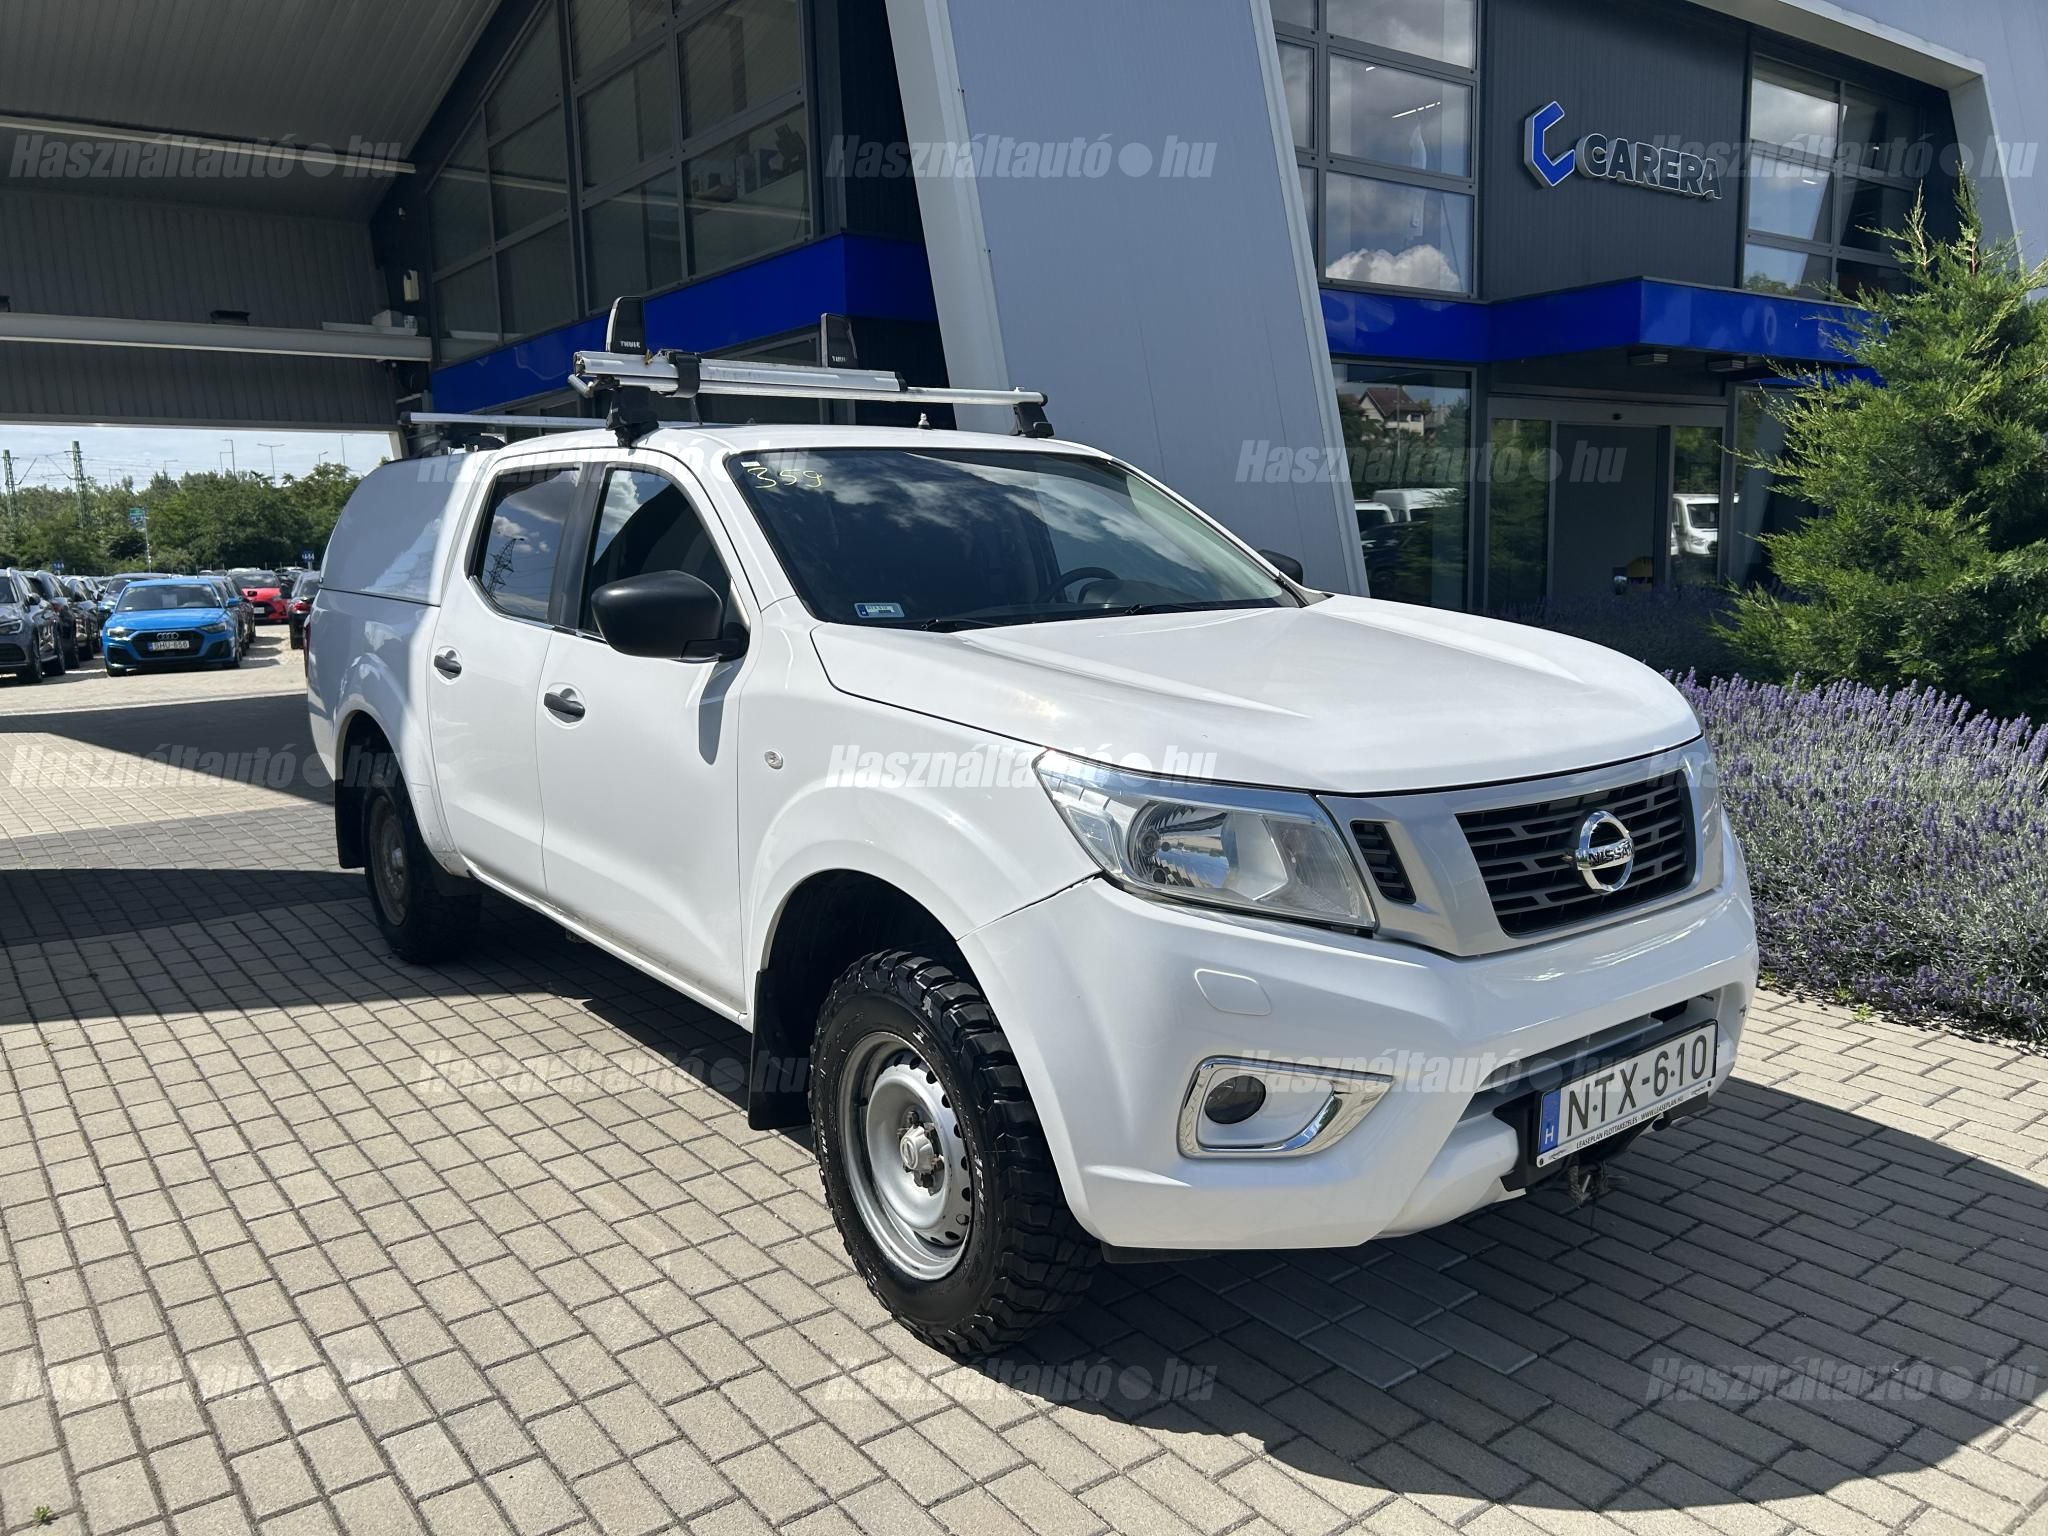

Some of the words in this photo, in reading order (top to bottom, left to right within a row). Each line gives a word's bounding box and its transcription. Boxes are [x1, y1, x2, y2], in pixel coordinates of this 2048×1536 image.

[1578, 133, 1722, 200] CARERA
[747, 467, 823, 488] 359
[1544, 1125, 1555, 1145] H
[1576, 1132, 1604, 1149] LEASEPLAN
